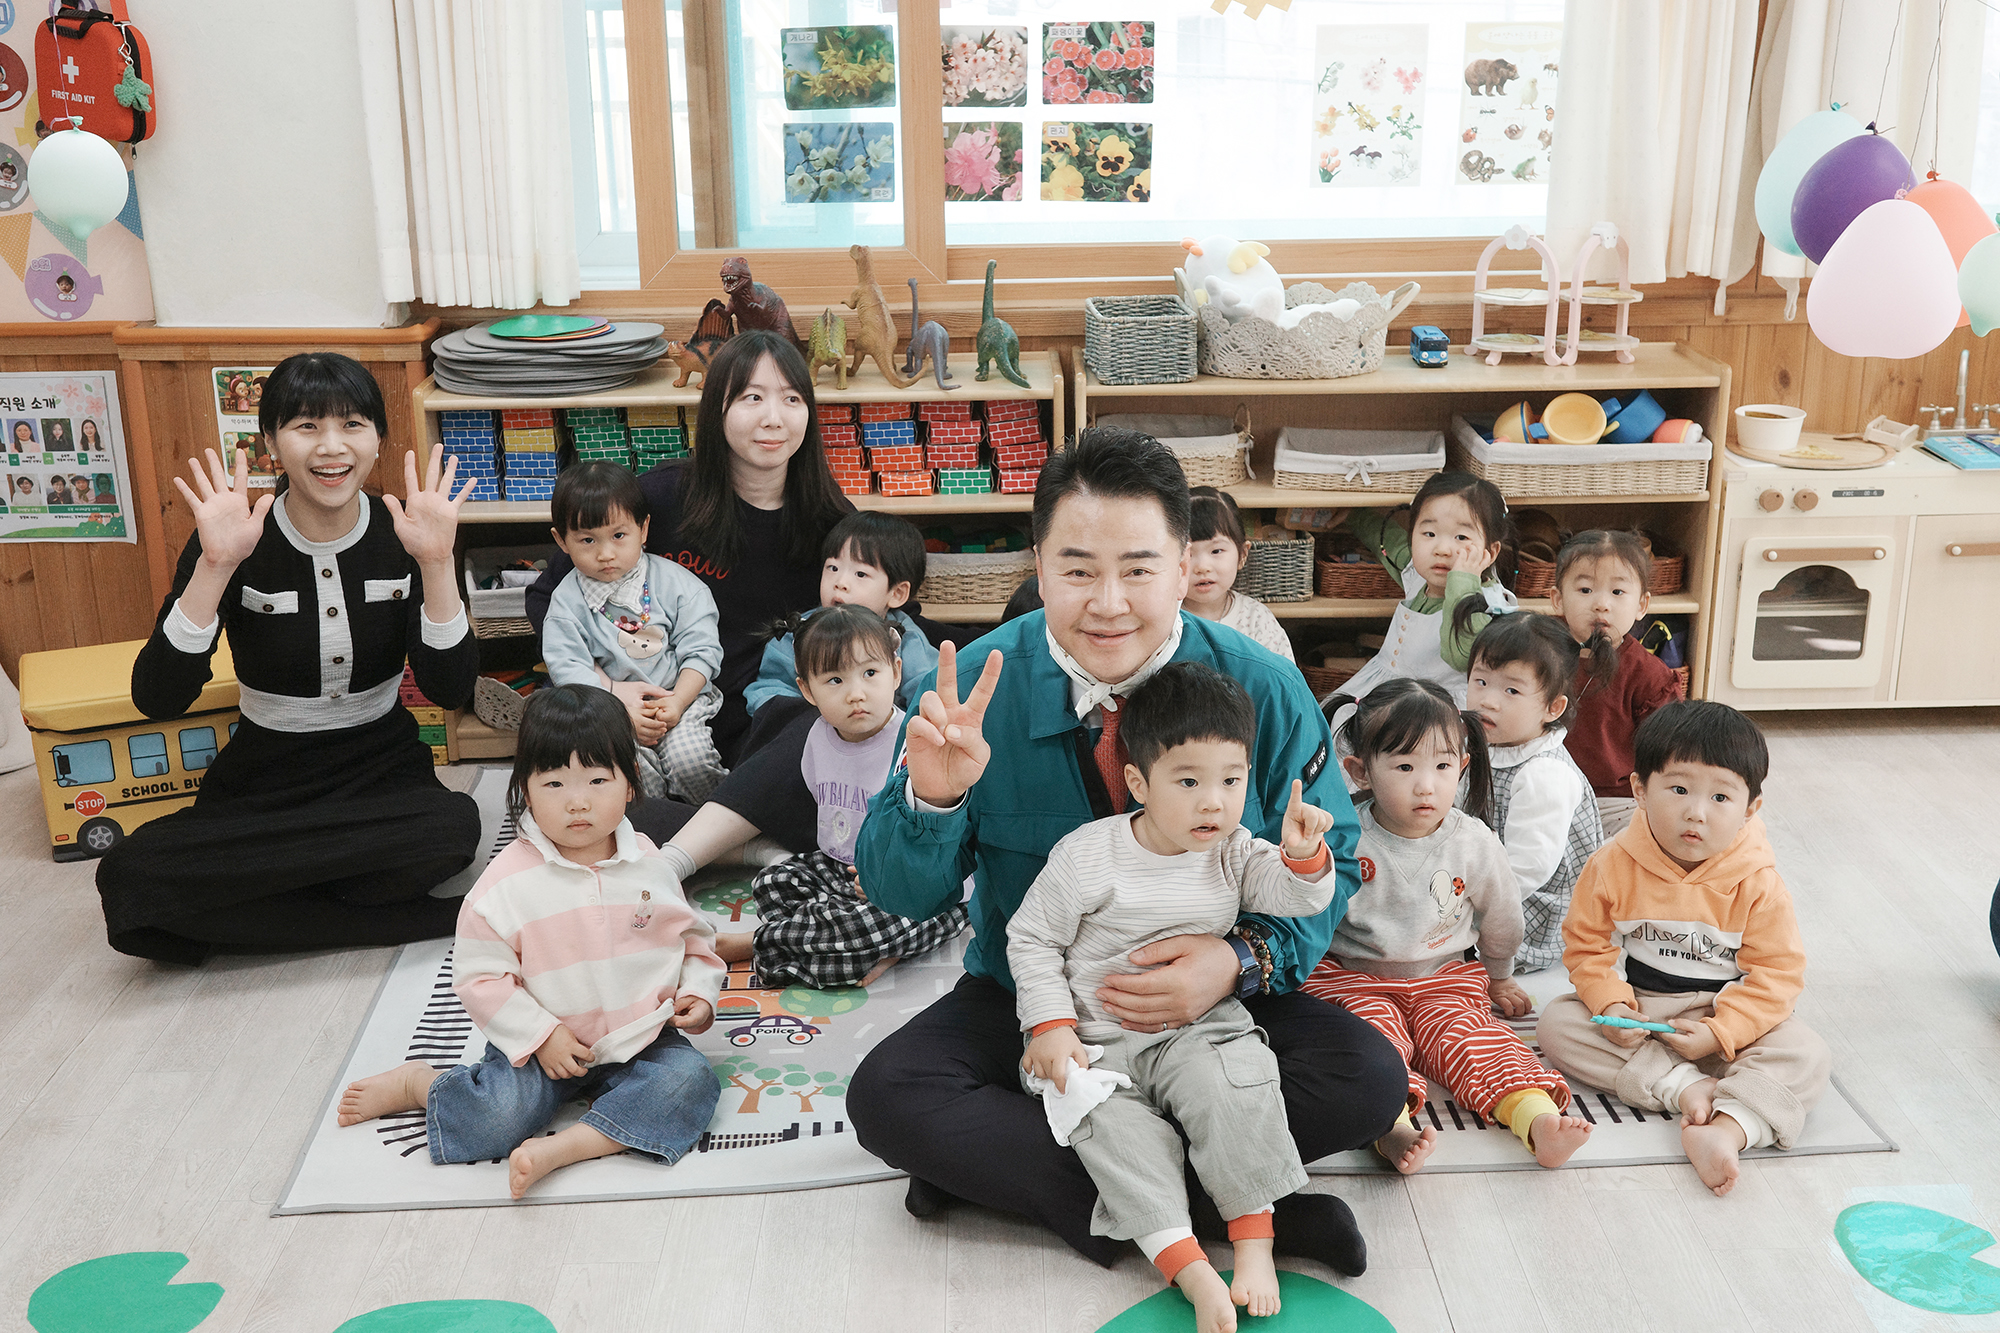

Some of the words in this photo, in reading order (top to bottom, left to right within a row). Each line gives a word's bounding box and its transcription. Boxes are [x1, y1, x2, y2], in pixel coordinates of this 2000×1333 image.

[51, 89, 69, 101] FIRST
[71, 94, 83, 102] AID
[83, 95, 96, 105] KIT
[31, 396, 57, 410] 소개
[121, 781, 179, 799] SCHOOL
[183, 776, 204, 790] BU
[77, 798, 104, 810] STOP
[1658, 947, 1678, 958] NEW
[760, 990, 783, 998] Ca
[755, 1027, 796, 1035] Police
